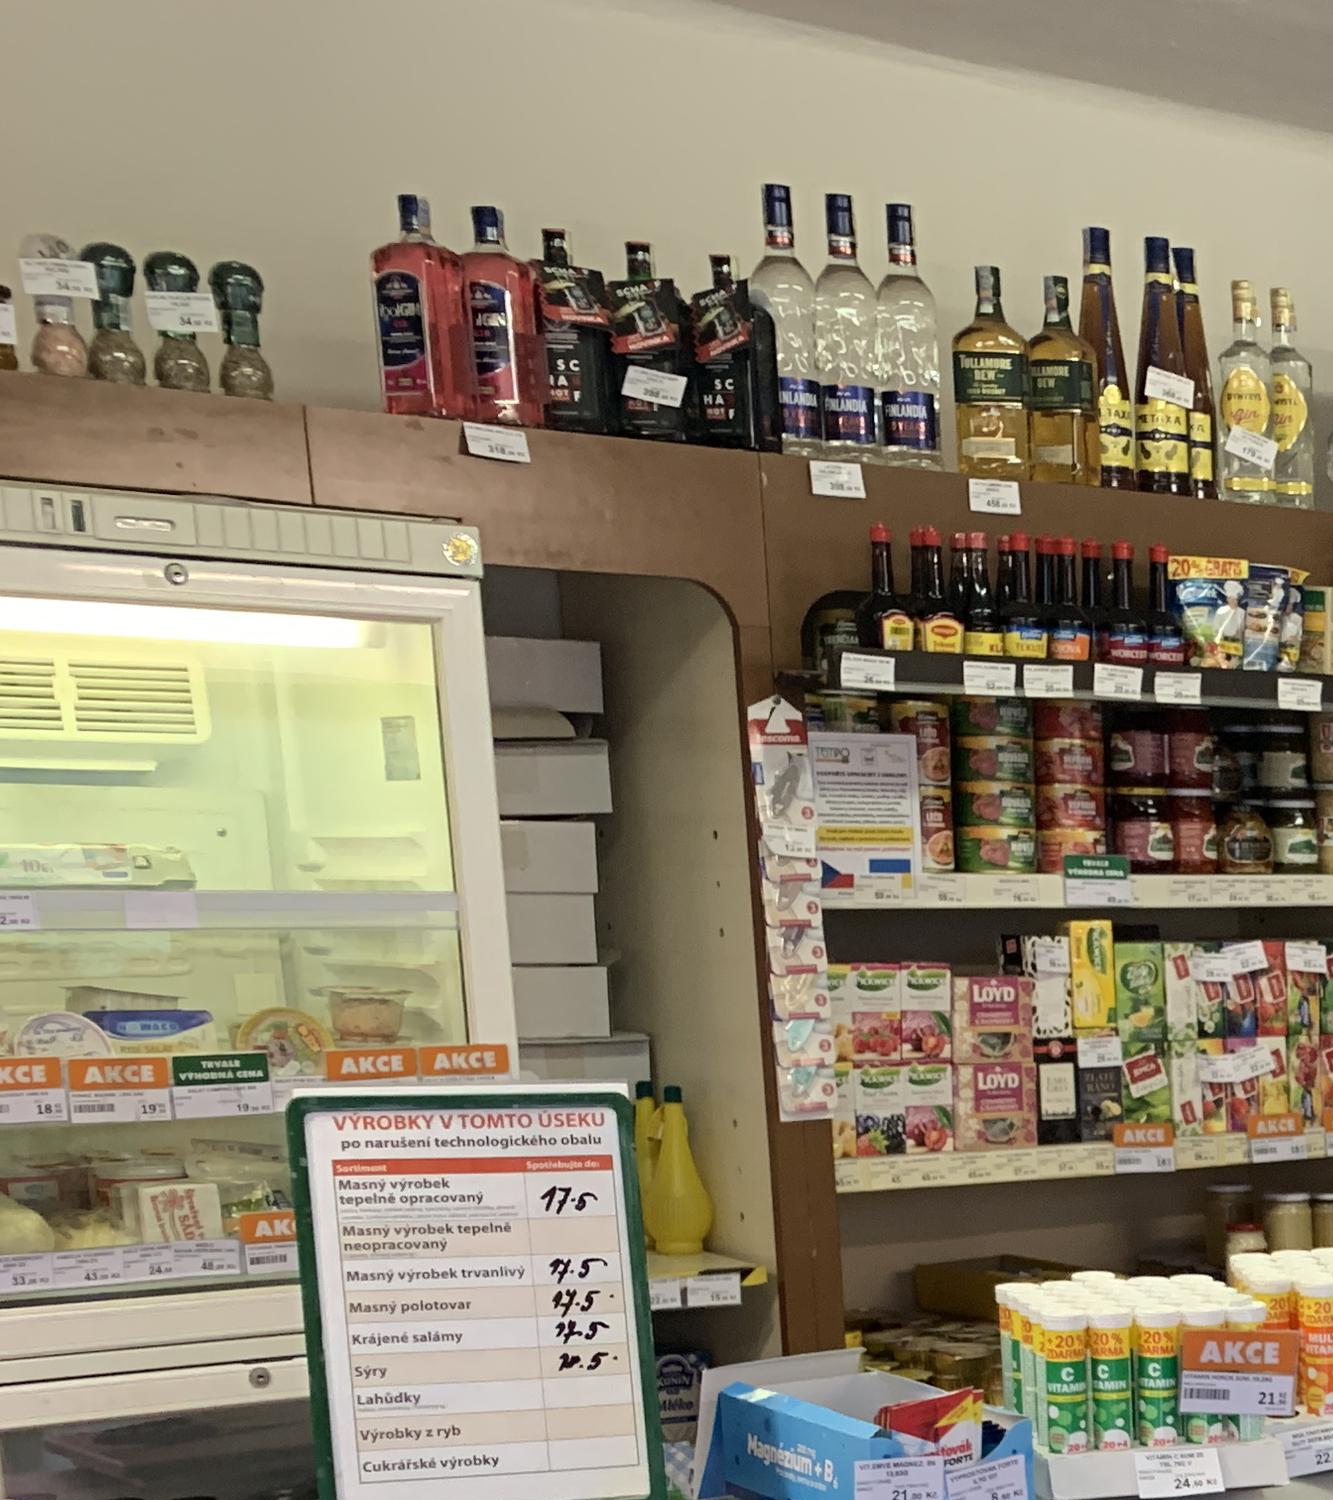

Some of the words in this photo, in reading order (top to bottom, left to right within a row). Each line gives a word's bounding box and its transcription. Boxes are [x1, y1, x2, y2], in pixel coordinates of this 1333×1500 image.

[972, 983, 1015, 1003] LOYD
[340, 1055, 404, 1076] AKCE
[433, 1051, 497, 1071] AKCE
[83, 1064, 155, 1086] AKCE
[977, 1071, 1019, 1090] LOYD
[332, 1113, 434, 1132] VÝROBKY
[439, 1114, 455, 1131] V
[458, 1112, 534, 1130] TOMTO
[537, 1108, 606, 1129] ÚSEKU
[340, 1138, 361, 1151] po
[364, 1133, 431, 1149] narušení
[433, 1133, 557, 1148] technologického
[560, 1133, 602, 1147] obalu
[335, 1162, 388, 1174] Sortiment
[338, 1177, 382, 1192] Masný
[385, 1176, 451, 1190] výrobek
[339, 1191, 396, 1206] tepelně
[398, 1190, 484, 1206] opracovaný
[342, 1222, 391, 1239] Masný
[393, 1220, 456, 1236] výrobek
[457, 1221, 513, 1238] tepelně
[343, 1237, 448, 1253] neopracovaný
[345, 1266, 395, 1284] Masný
[397, 1265, 458, 1281] výrobek
[460, 1264, 526, 1281] trvanlivý
[349, 1297, 397, 1315] Masný
[400, 1297, 472, 1314] polotovar
[351, 1329, 409, 1346] Krájené
[411, 1328, 463, 1346] salámy
[1201, 1340, 1281, 1365] AKCE
[354, 1364, 388, 1382] Sýry
[1060, 1366, 1075, 1381] C
[356, 1389, 422, 1407] Lahůdky
[360, 1425, 423, 1443] Výrobky
[425, 1429, 434, 1439] z
[436, 1424, 462, 1440] ryb
[362, 1456, 438, 1474] Cukrářské
[439, 1453, 500, 1470] výrobky
